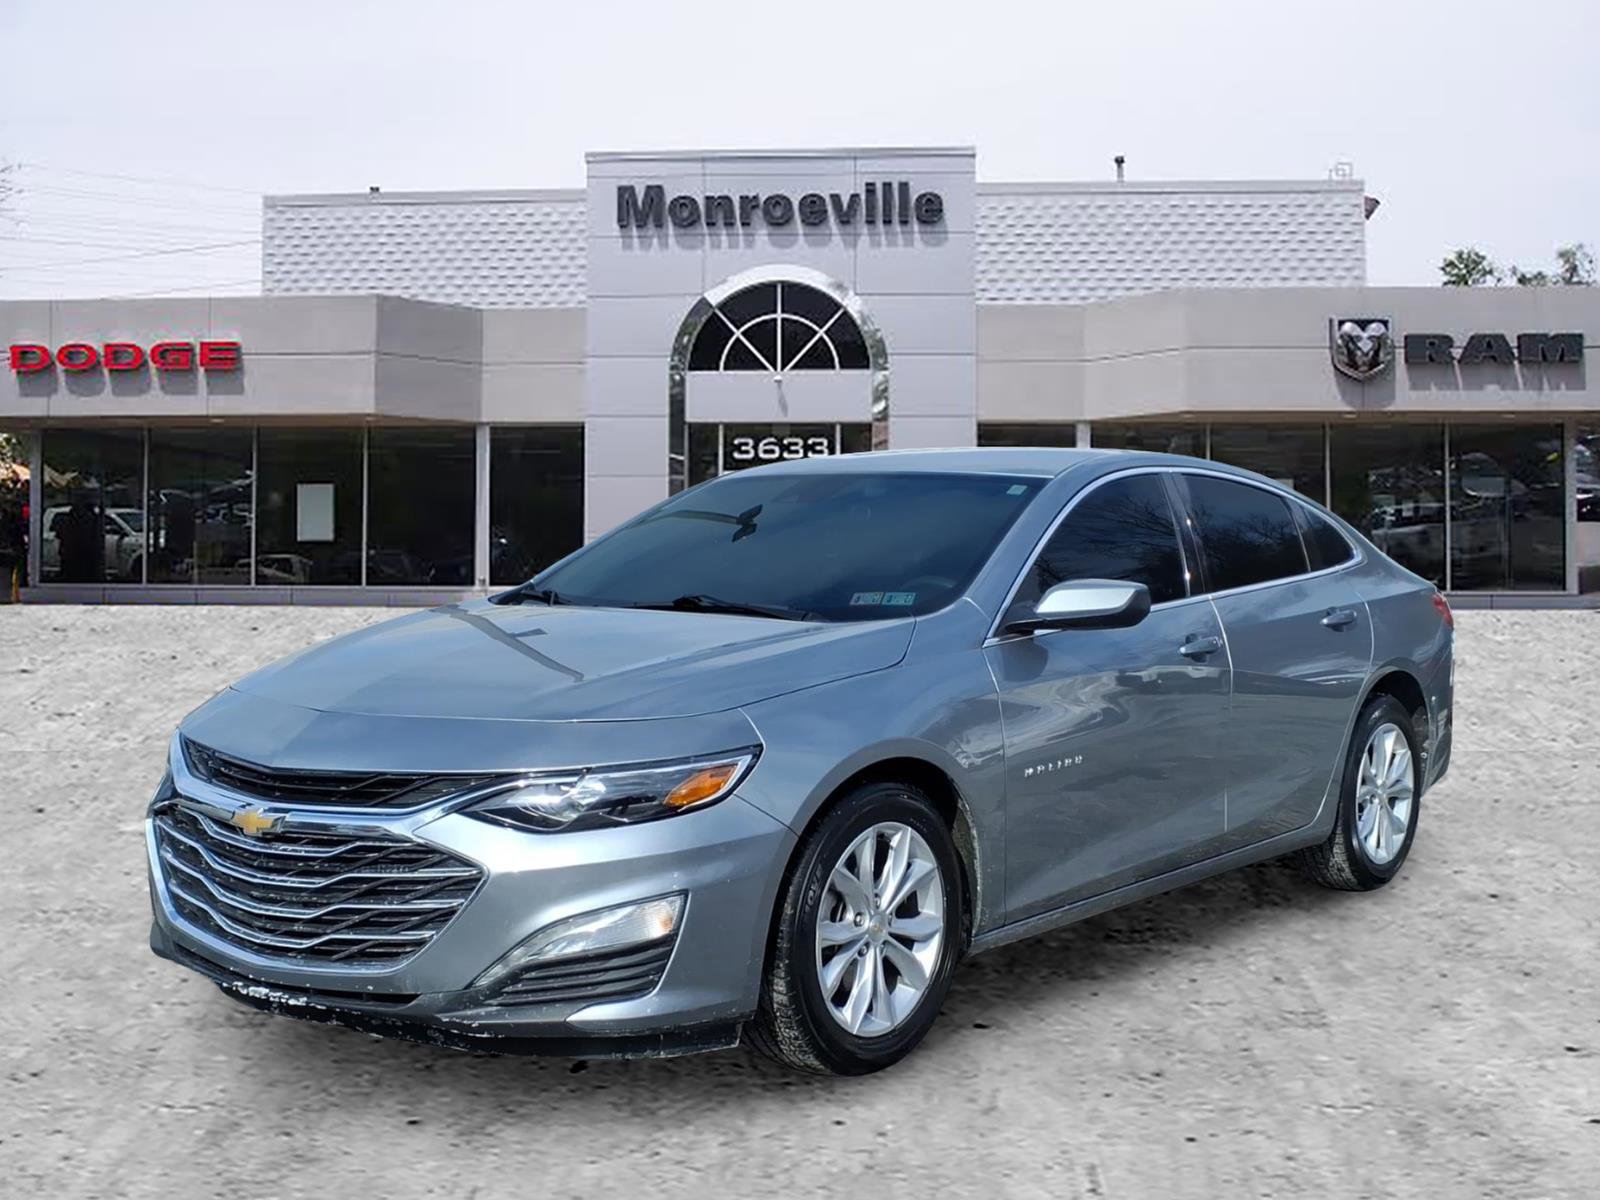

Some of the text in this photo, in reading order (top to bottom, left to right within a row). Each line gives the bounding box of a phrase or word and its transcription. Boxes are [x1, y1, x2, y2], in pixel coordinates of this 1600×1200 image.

[617, 182, 943, 228] Monroeville
[9, 341, 242, 370] DODGE
[1404, 333, 1584, 364] RAM
[732, 437, 828, 459] 3633
